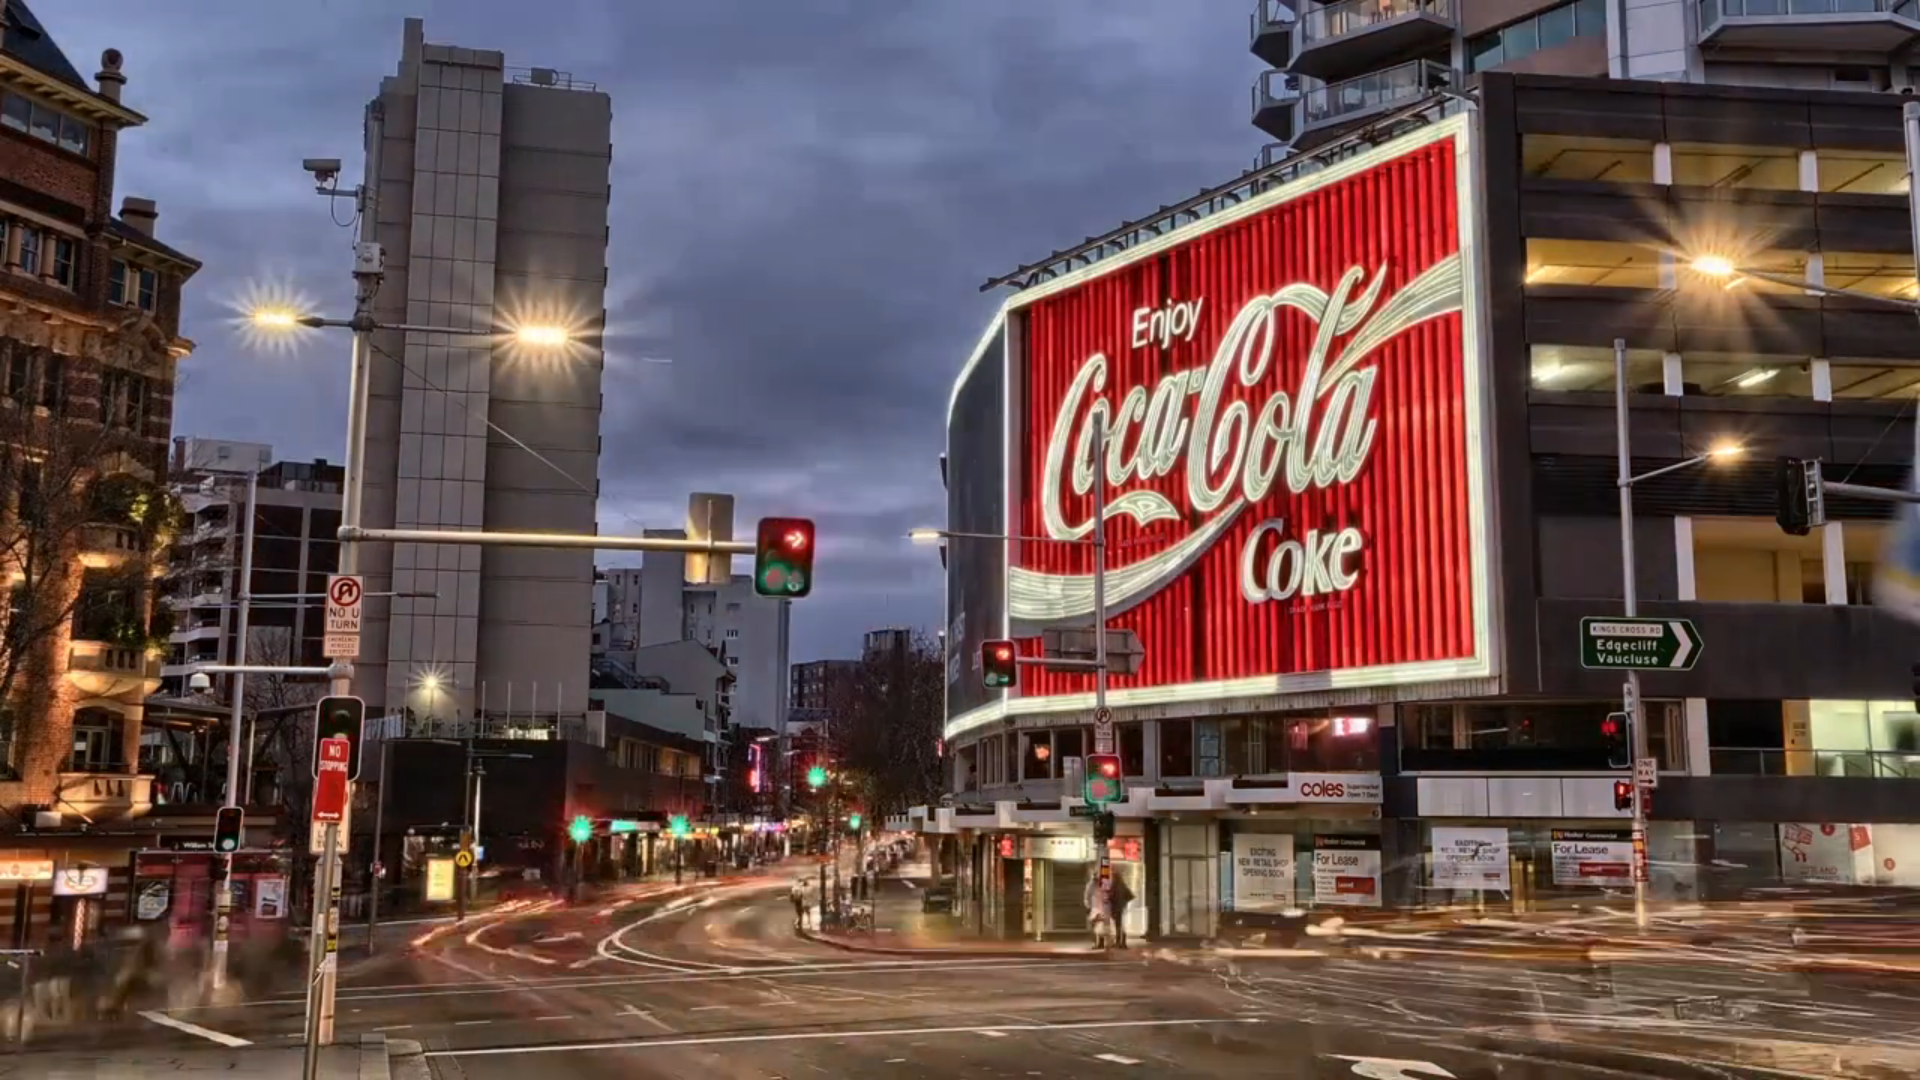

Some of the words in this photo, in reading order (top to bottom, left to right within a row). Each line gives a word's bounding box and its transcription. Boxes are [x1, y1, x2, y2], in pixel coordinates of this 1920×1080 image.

[1132, 297, 1203, 350] Enjoy
[1043, 260, 1388, 541] Coca-Cola
[1240, 518, 1364, 604] Coke
[329, 607, 345, 617] NO
[352, 607, 360, 618] U
[330, 620, 358, 629] TURN
[1592, 626, 1617, 634] KINGS
[1620, 626, 1646, 634] CROSS
[1597, 639, 1657, 653] Edgecliff
[1597, 653, 1659, 665] Vaucluse
[328, 744, 341, 758] NO
[320, 761, 348, 771] STOPPING
[1638, 760, 1653, 768] ONE
[1301, 780, 1344, 797] coles
[1554, 845, 1572, 854] For
[1575, 844, 1608, 854] Lease
[1273, 859, 1289, 868] SHOP
[1317, 853, 1330, 865] For
[1332, 853, 1358, 866] Lease
[1269, 869, 1285, 878] SOON
